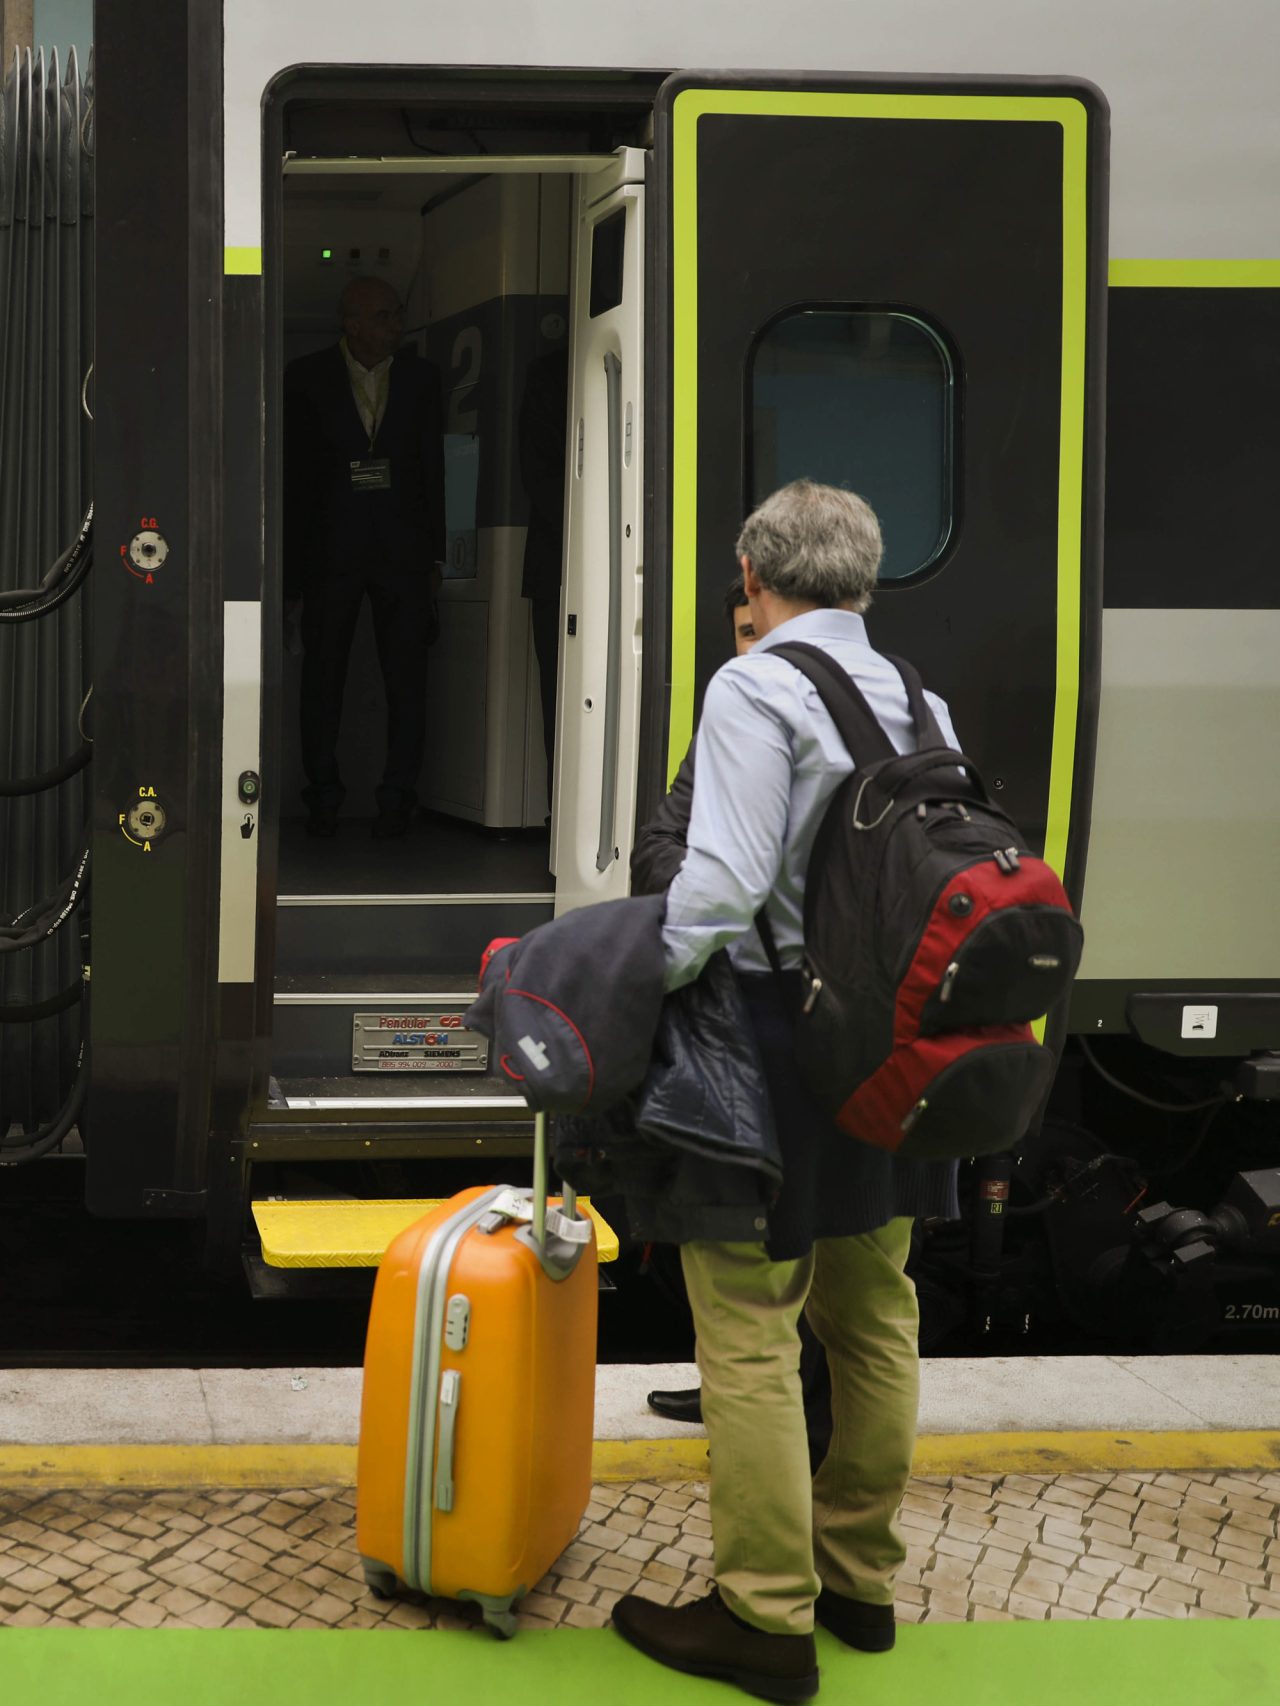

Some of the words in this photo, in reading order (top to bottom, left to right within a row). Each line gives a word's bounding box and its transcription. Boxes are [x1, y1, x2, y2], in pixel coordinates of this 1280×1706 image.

[120, 544, 127, 556] F
[145, 572, 154, 584] A
[138, 786, 157, 797] C.A.
[119, 813, 126, 825] F
[143, 841, 152, 852] A
[379, 1016, 431, 1028] Pendular
[1097, 1019, 1103, 1028] 2
[392, 1032, 448, 1045] ALSTOM
[423, 1050, 461, 1058] SIEMENS
[1225, 1304, 1279, 1319] 2.70m
